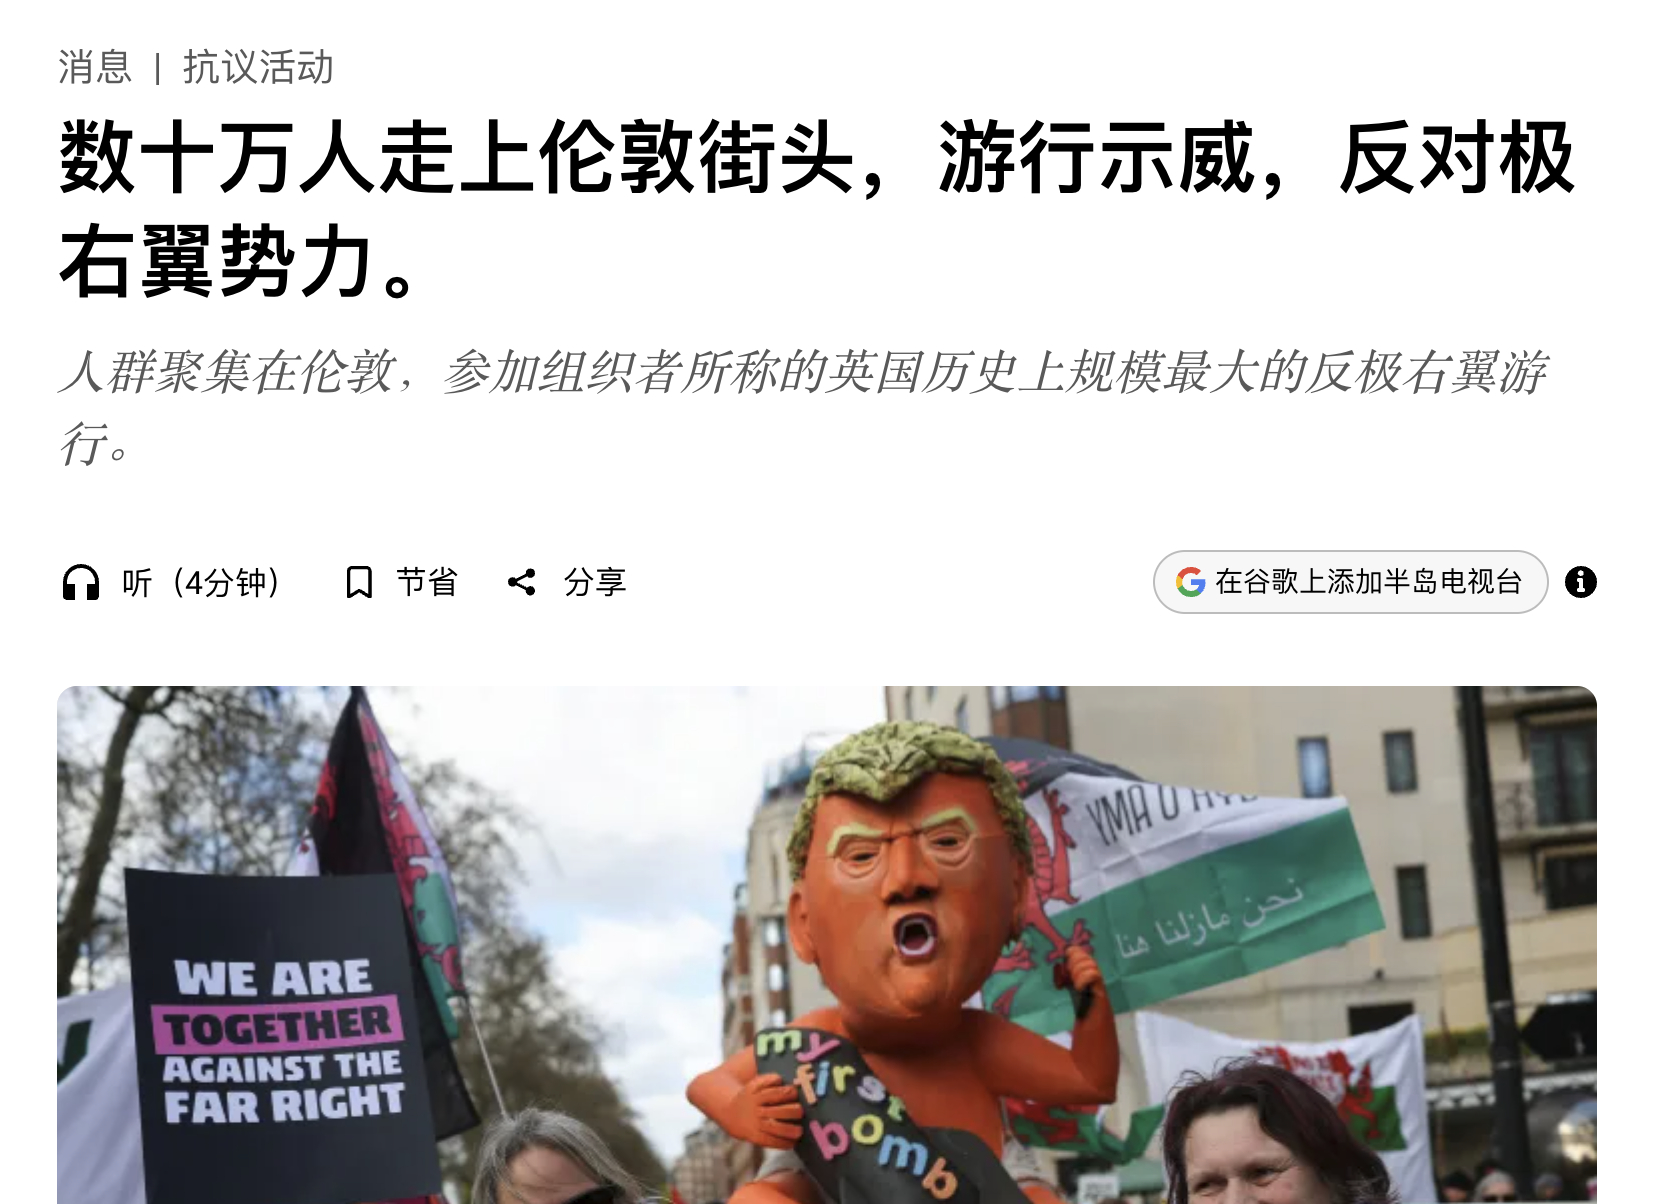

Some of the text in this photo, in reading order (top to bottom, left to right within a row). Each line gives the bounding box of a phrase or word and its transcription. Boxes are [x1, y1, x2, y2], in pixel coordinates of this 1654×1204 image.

[59, 49, 131, 84] 消息
[183, 48, 332, 84] 抗议活动
[60, 118, 1575, 200] 数十万人走上伦敦街头，游行示威，反对极
[59, 222, 409, 299] 右翼势力。
[61, 421, 124, 466] 行。
[397, 566, 458, 597] 节省
[564, 567, 626, 597] 分享
[1216, 566, 1523, 596] 在谷歌上添加半岛电视台
[1086, 785, 1152, 846] YMA
[1243, 877, 1304, 927] نحن
[174, 958, 373, 996] WE ARE
[163, 1004, 392, 1046] TOGETHER
[756, 1029, 841, 1062] my
[162, 1050, 402, 1083] AGAINST THE
[164, 1082, 405, 1124] FAR RIGHT
[793, 1060, 906, 1122] first
[809, 1114, 958, 1200] bomb
